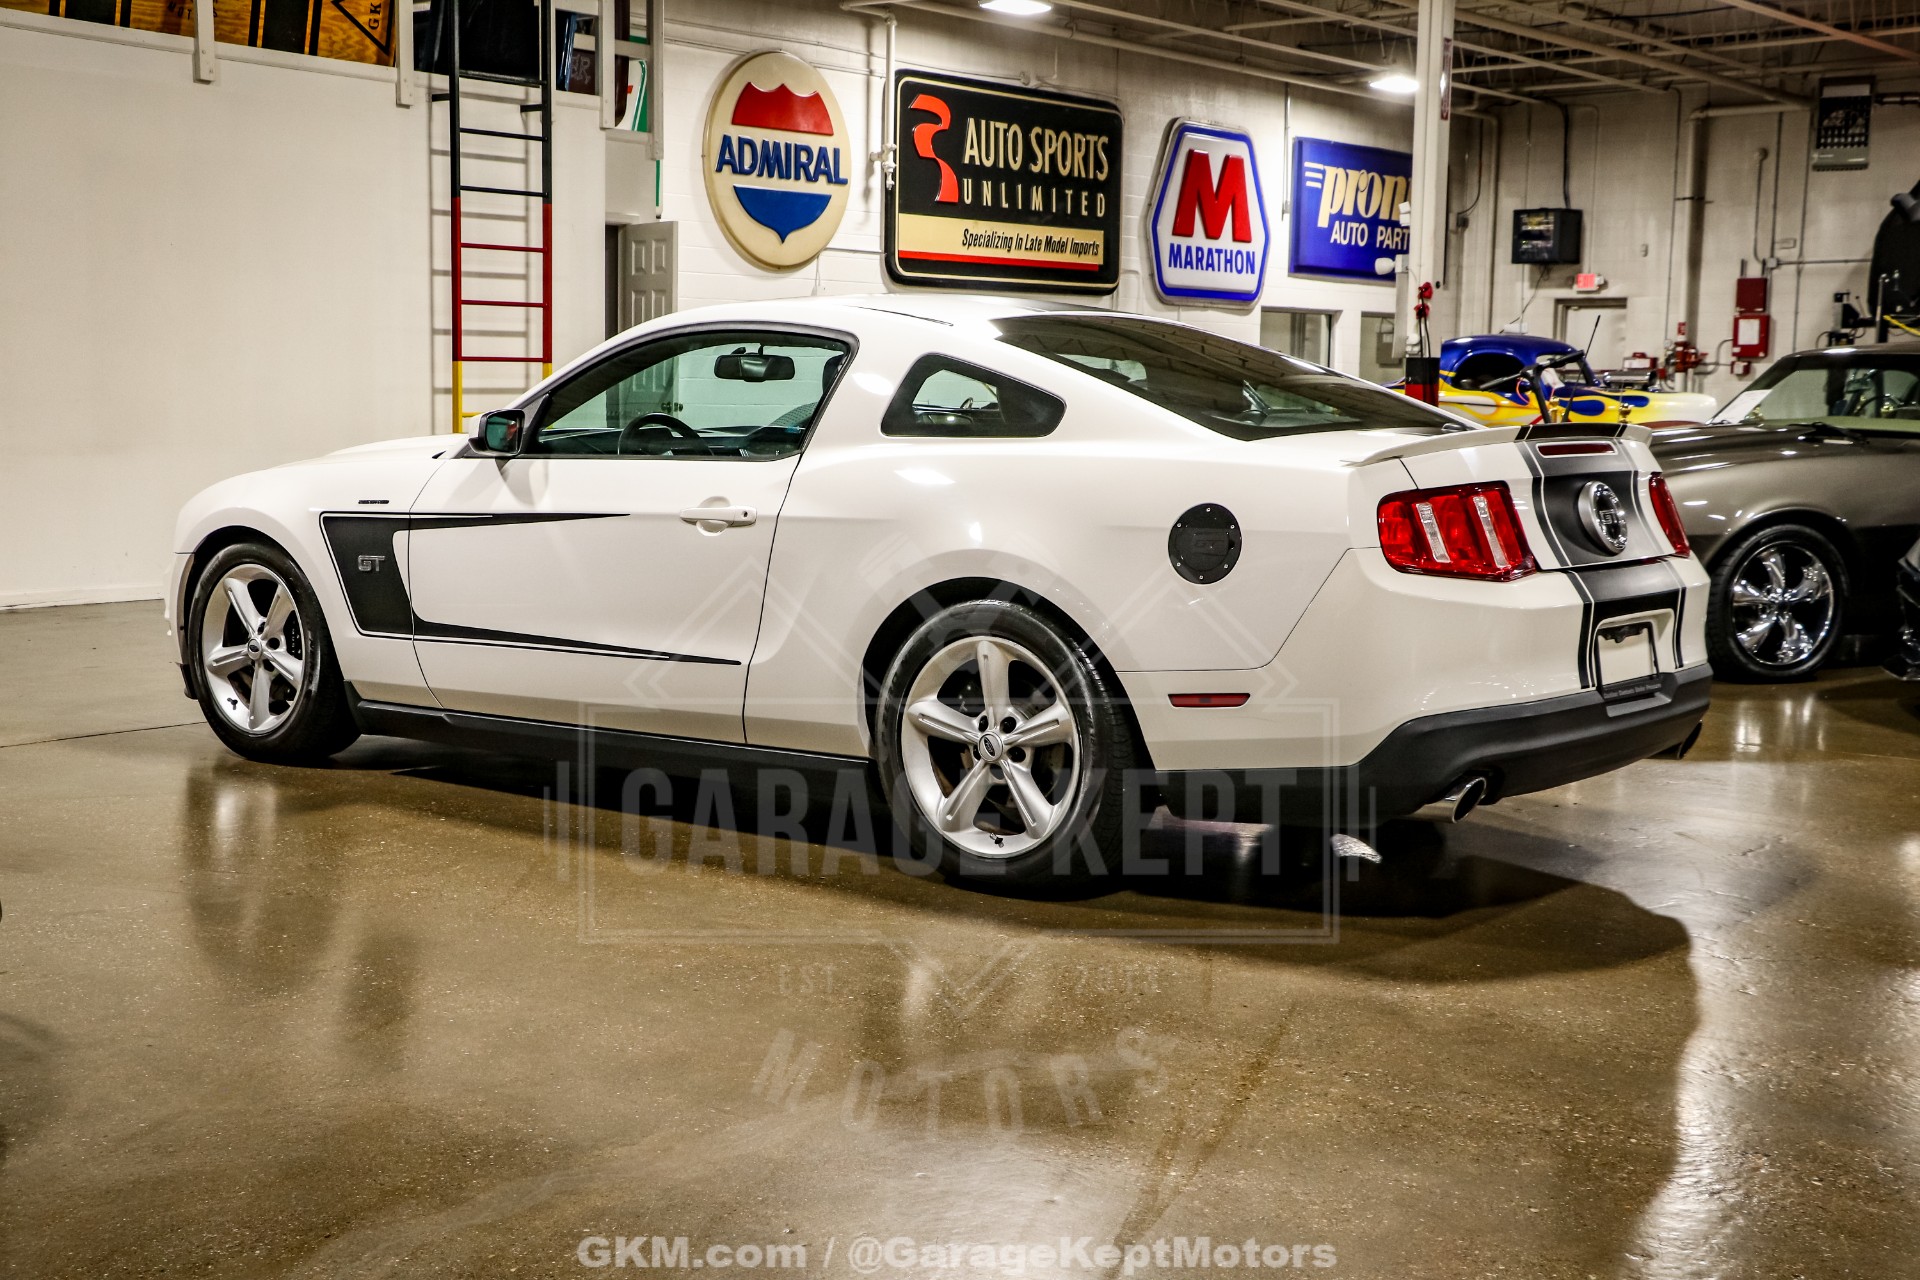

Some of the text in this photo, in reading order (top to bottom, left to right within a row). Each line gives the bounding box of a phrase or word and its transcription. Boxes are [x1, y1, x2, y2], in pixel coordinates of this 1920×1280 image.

[715, 133, 848, 185] ADMIRAL
[964, 117, 1109, 181] AUTO SPORTS
[962, 178, 1106, 218] UNLIMITED
[1172, 148, 1252, 243] M
[1317, 165, 1412, 228] pron
[962, 228, 1100, 258] Specializing In Late Model Imports
[1330, 220, 1369, 247] AUTO
[1168, 243, 1256, 274] MARATHON
[358, 554, 386, 572] GT
